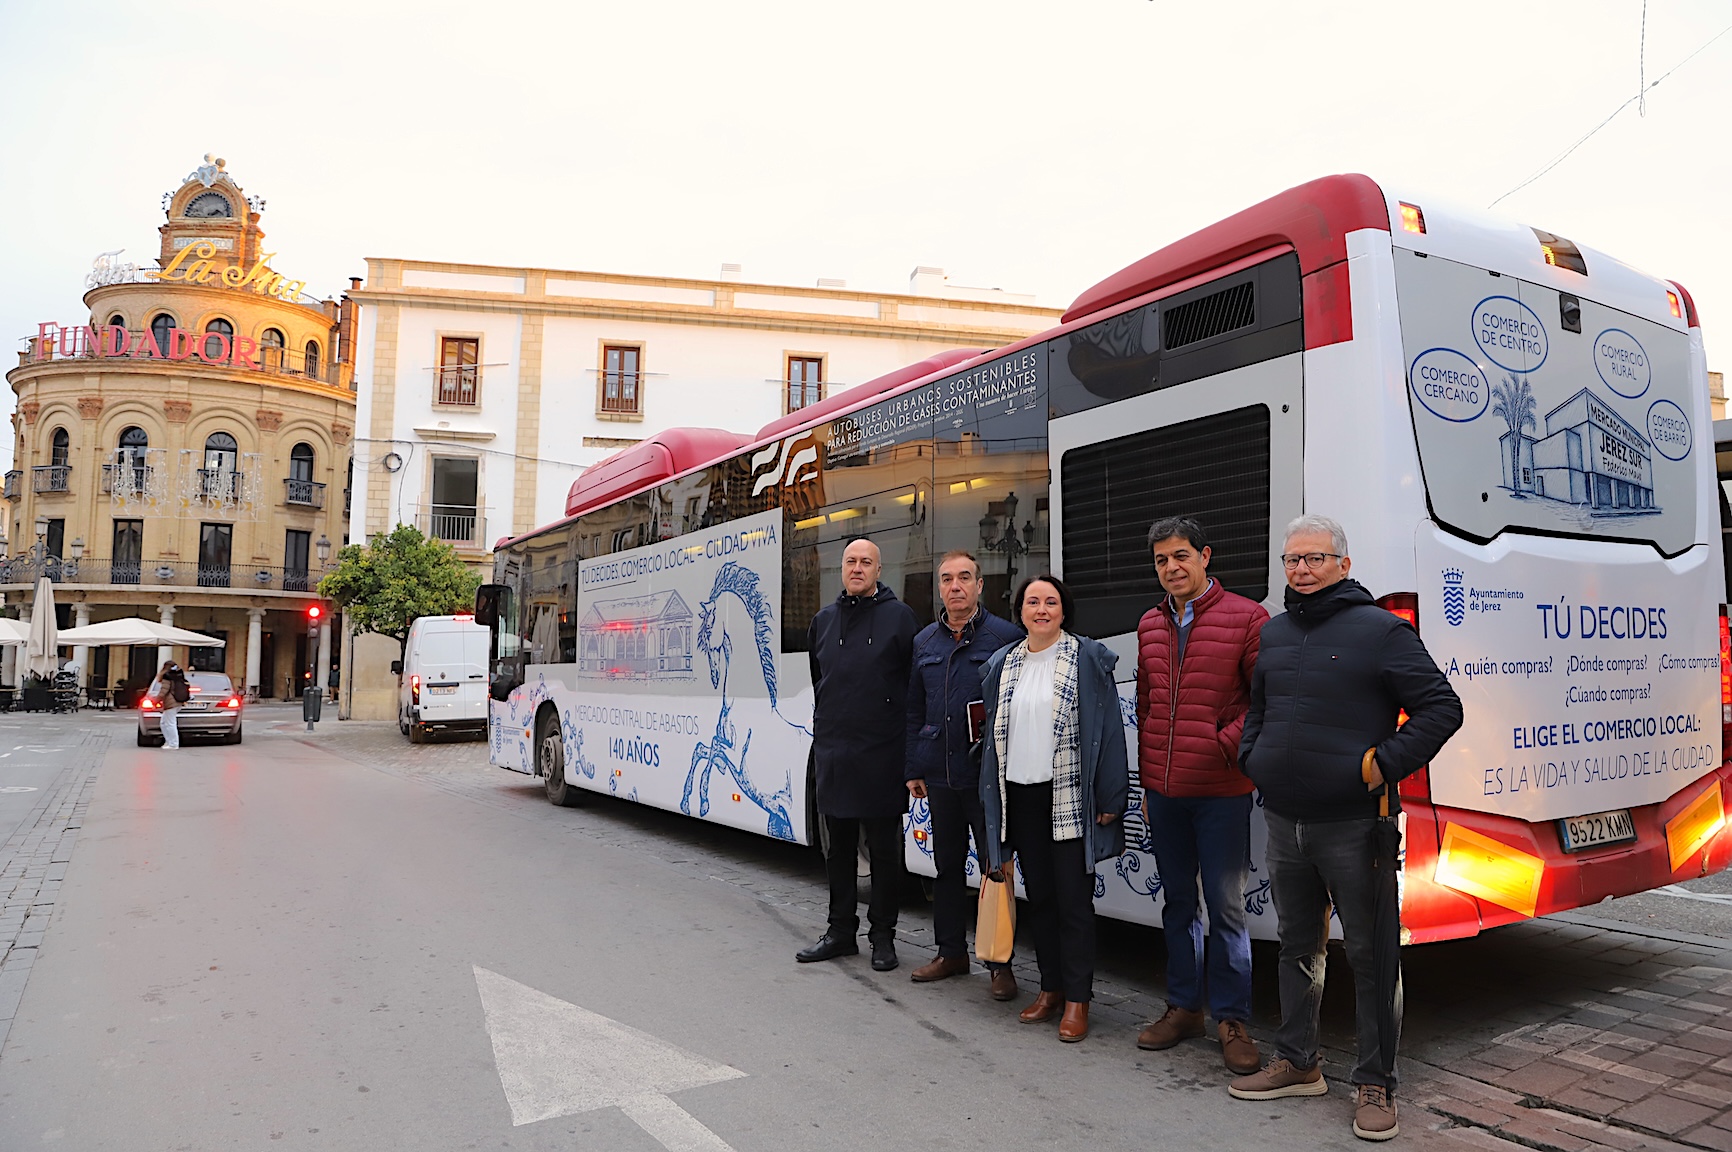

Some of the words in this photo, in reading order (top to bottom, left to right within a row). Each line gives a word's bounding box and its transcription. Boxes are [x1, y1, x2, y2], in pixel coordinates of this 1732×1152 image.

[144, 240, 217, 284] La
[221, 248, 307, 302] Ina
[1482, 312, 1539, 338] COMERCIO
[36, 321, 264, 371] FUNDADOR
[1481, 329, 1497, 346] DE
[1499, 333, 1542, 356] CENTRO
[1601, 343, 1644, 367] COMERCIO
[1420, 366, 1480, 389] COMERCIO
[1611, 358, 1637, 381] RURAL
[827, 408, 882, 438] AUTOBUSES
[888, 386, 941, 416] URBANOS
[949, 352, 1036, 395] SOSTENIBLES
[827, 435, 846, 451] PARA
[847, 416, 897, 444] REDUCCIÓN
[898, 412, 910, 427] DE
[912, 402, 940, 422] GASES
[942, 369, 1036, 412] CONTAMINANTES
[1424, 383, 1479, 405] CERCANO
[1590, 402, 1621, 436] MERCADO
[1652, 414, 1687, 433] COMERCIO
[1599, 432, 1628, 464] JEREZ
[1628, 448, 1643, 470] SUR
[1654, 428, 1663, 441] DE
[1664, 431, 1687, 446] BARRIO
[620, 554, 662, 579] COMERCIO
[664, 545, 695, 570] LOCAL
[706, 531, 749, 559] CIUDAD
[750, 524, 777, 549] VIVA
[1469, 587, 1524, 601] Ayuntamiento
[1469, 601, 1480, 611] de
[1480, 600, 1502, 613] Jerez
[1536, 595, 1571, 639] TÚ
[1580, 606, 1668, 640] DECIDES
[1464, 656, 1498, 681] quién
[1501, 655, 1553, 679] compras?
[1566, 655, 1604, 676] ¿Dónde
[1606, 654, 1648, 675] compras?
[1658, 653, 1687, 673] ¿Cómo
[1688, 653, 1720, 672] compras?
[1565, 685, 1607, 708] ¿Cúando
[1610, 683, 1651, 704] compras?
[574, 704, 609, 724] MERCADO
[609, 707, 644, 729] CENTRAL
[645, 711, 658, 731] DE
[658, 713, 699, 736] ABASTOS
[1513, 725, 1558, 749] ELIGE
[1562, 723, 1580, 745] EL
[1583, 717, 1657, 743] COMERCIO
[1659, 714, 1701, 735] LOCAL:
[609, 736, 625, 760] 140
[626, 735, 660, 767] AÑOS
[1483, 767, 1504, 796] ES
[1509, 765, 1529, 793] LA
[1533, 761, 1568, 789] VIDA
[1570, 759, 1581, 785] Y
[1584, 754, 1629, 783] SALUD
[1632, 751, 1651, 777] DE
[1654, 749, 1669, 774] LA
[1671, 743, 1714, 772] CIUDAD
[1569, 818, 1605, 845] 9522
[1604, 813, 1633, 838] KMN
